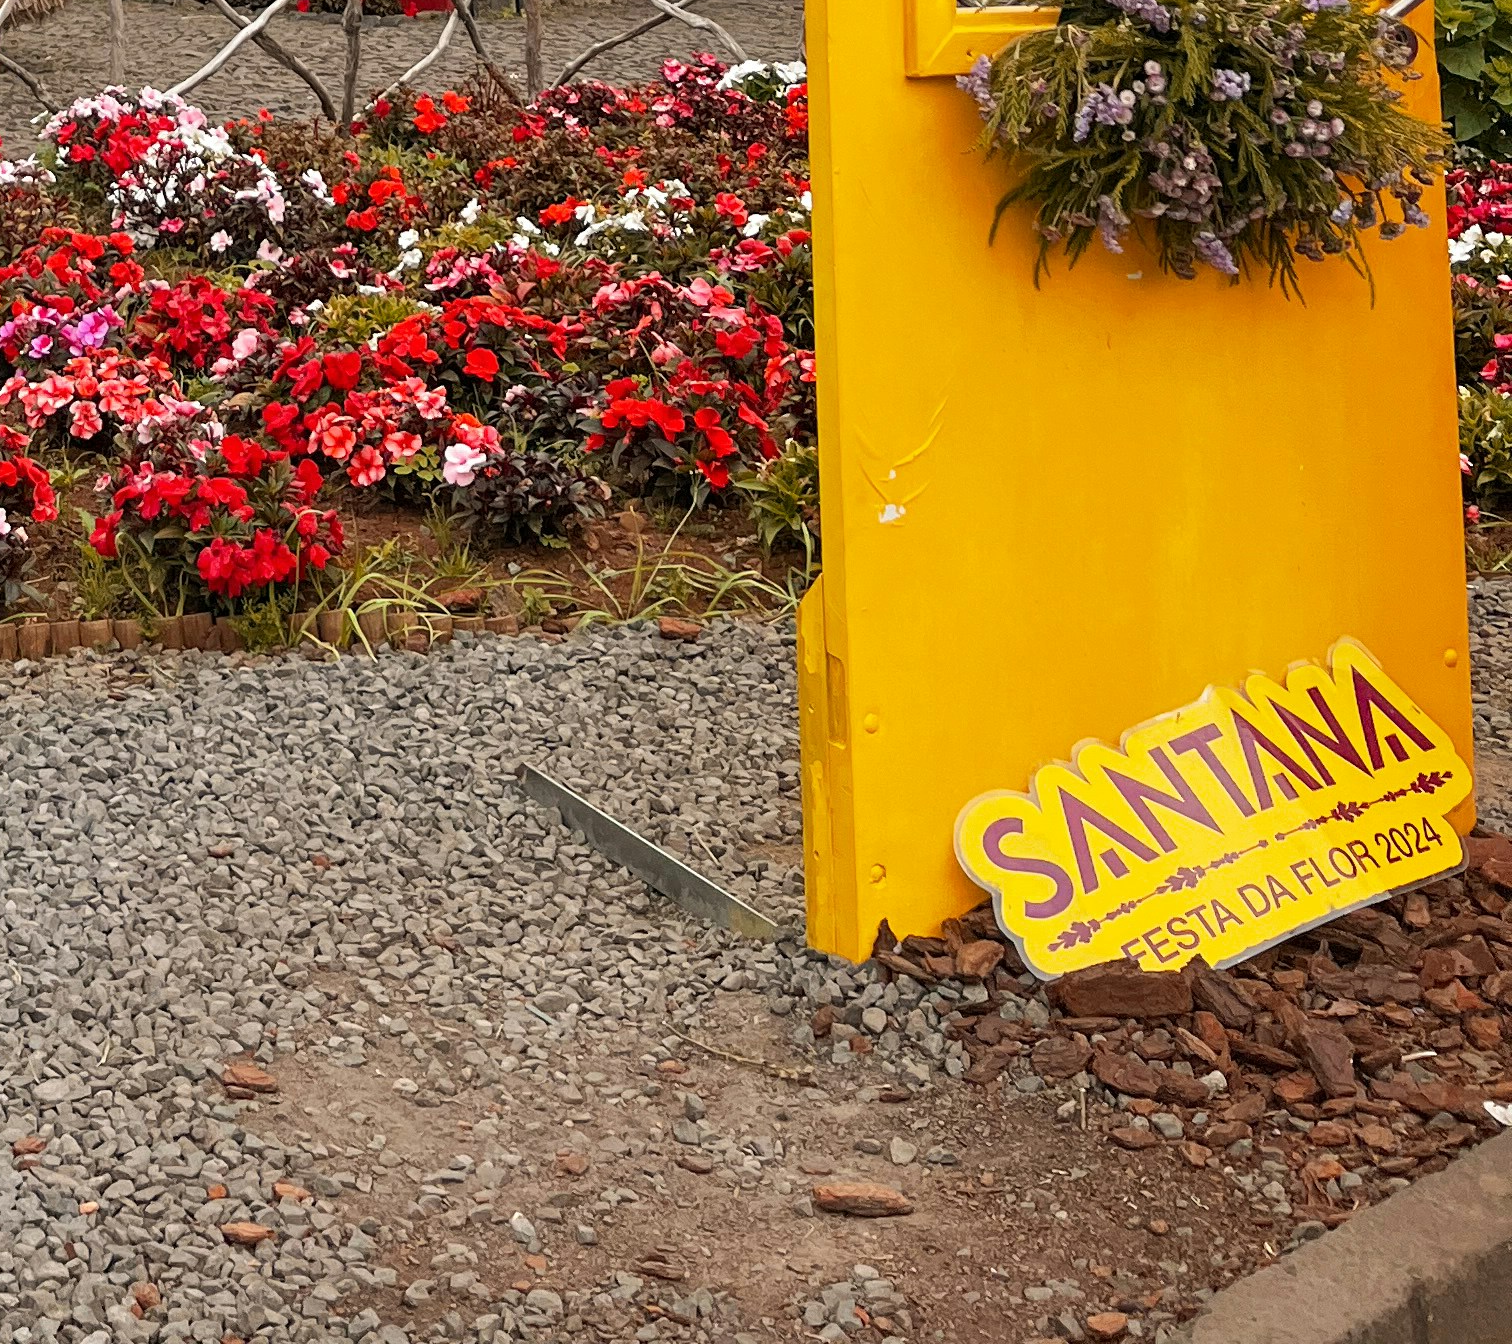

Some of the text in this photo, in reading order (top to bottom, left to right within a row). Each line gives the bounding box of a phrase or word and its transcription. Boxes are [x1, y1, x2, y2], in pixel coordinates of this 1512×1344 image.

[982, 664, 1436, 919] SANTANA
[1121, 817, 1443, 963] FESTA DA FLOR 2024
